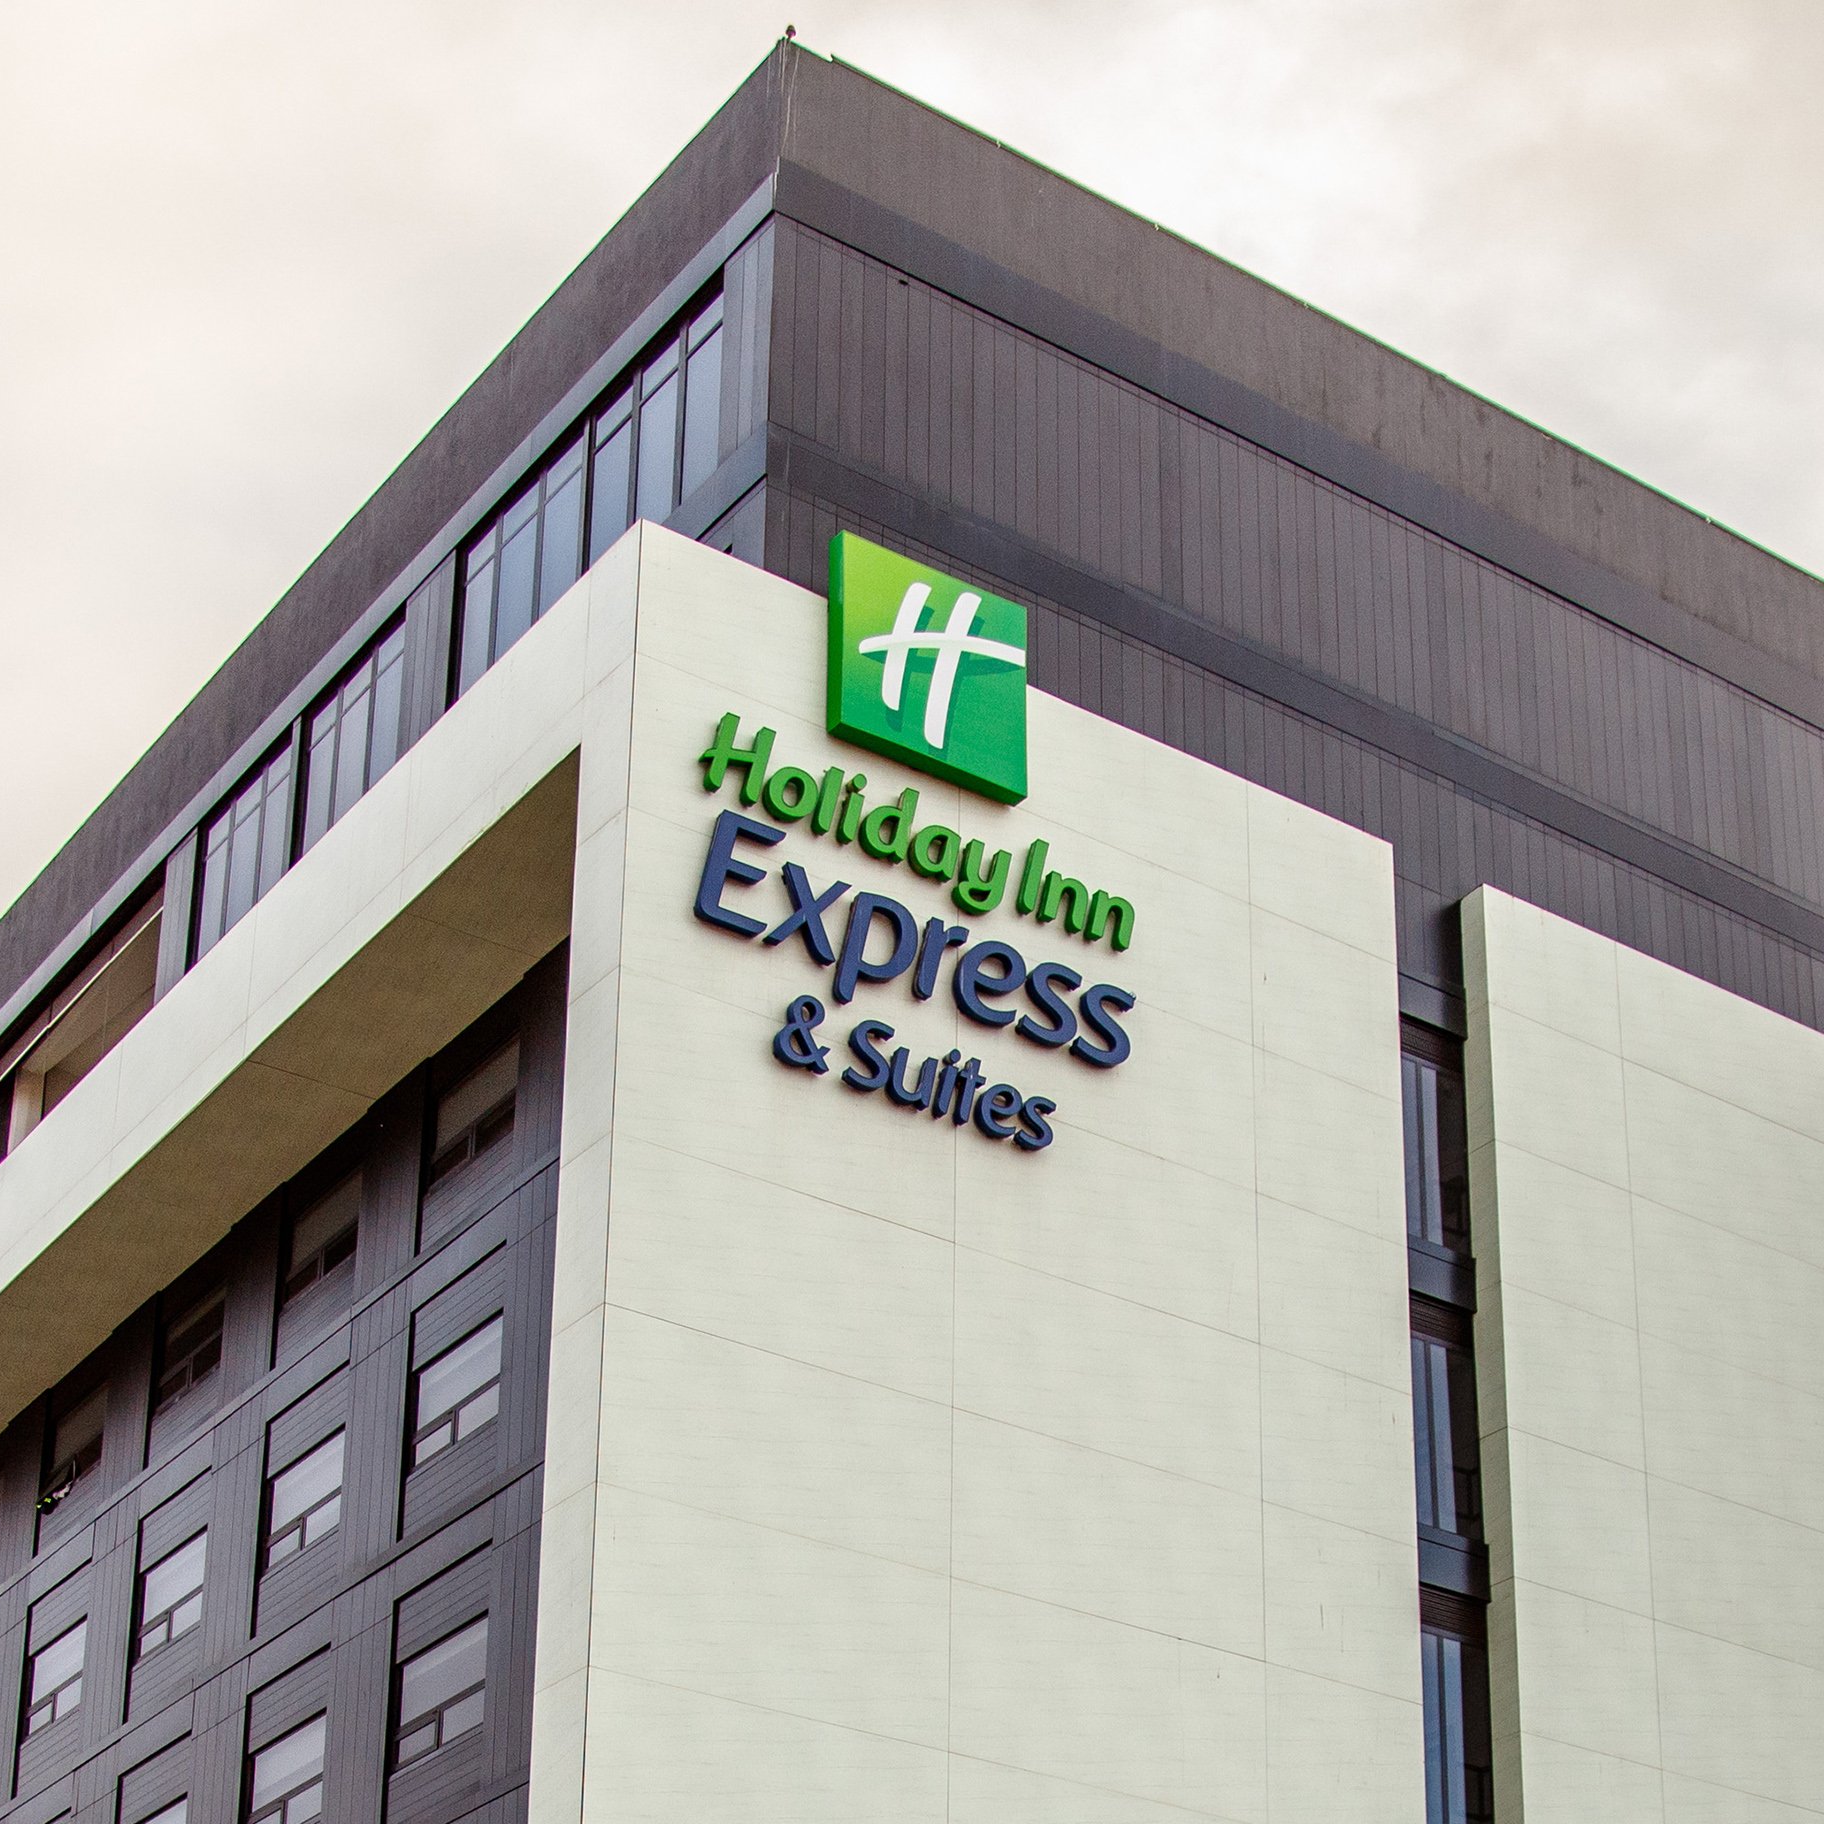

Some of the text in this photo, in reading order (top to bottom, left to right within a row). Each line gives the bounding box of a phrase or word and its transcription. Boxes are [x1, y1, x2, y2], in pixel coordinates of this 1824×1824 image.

[694, 809, 1136, 1068] Express
[698, 712, 1135, 952] Holiday Inn
[773, 994, 1057, 1151] & Suites
